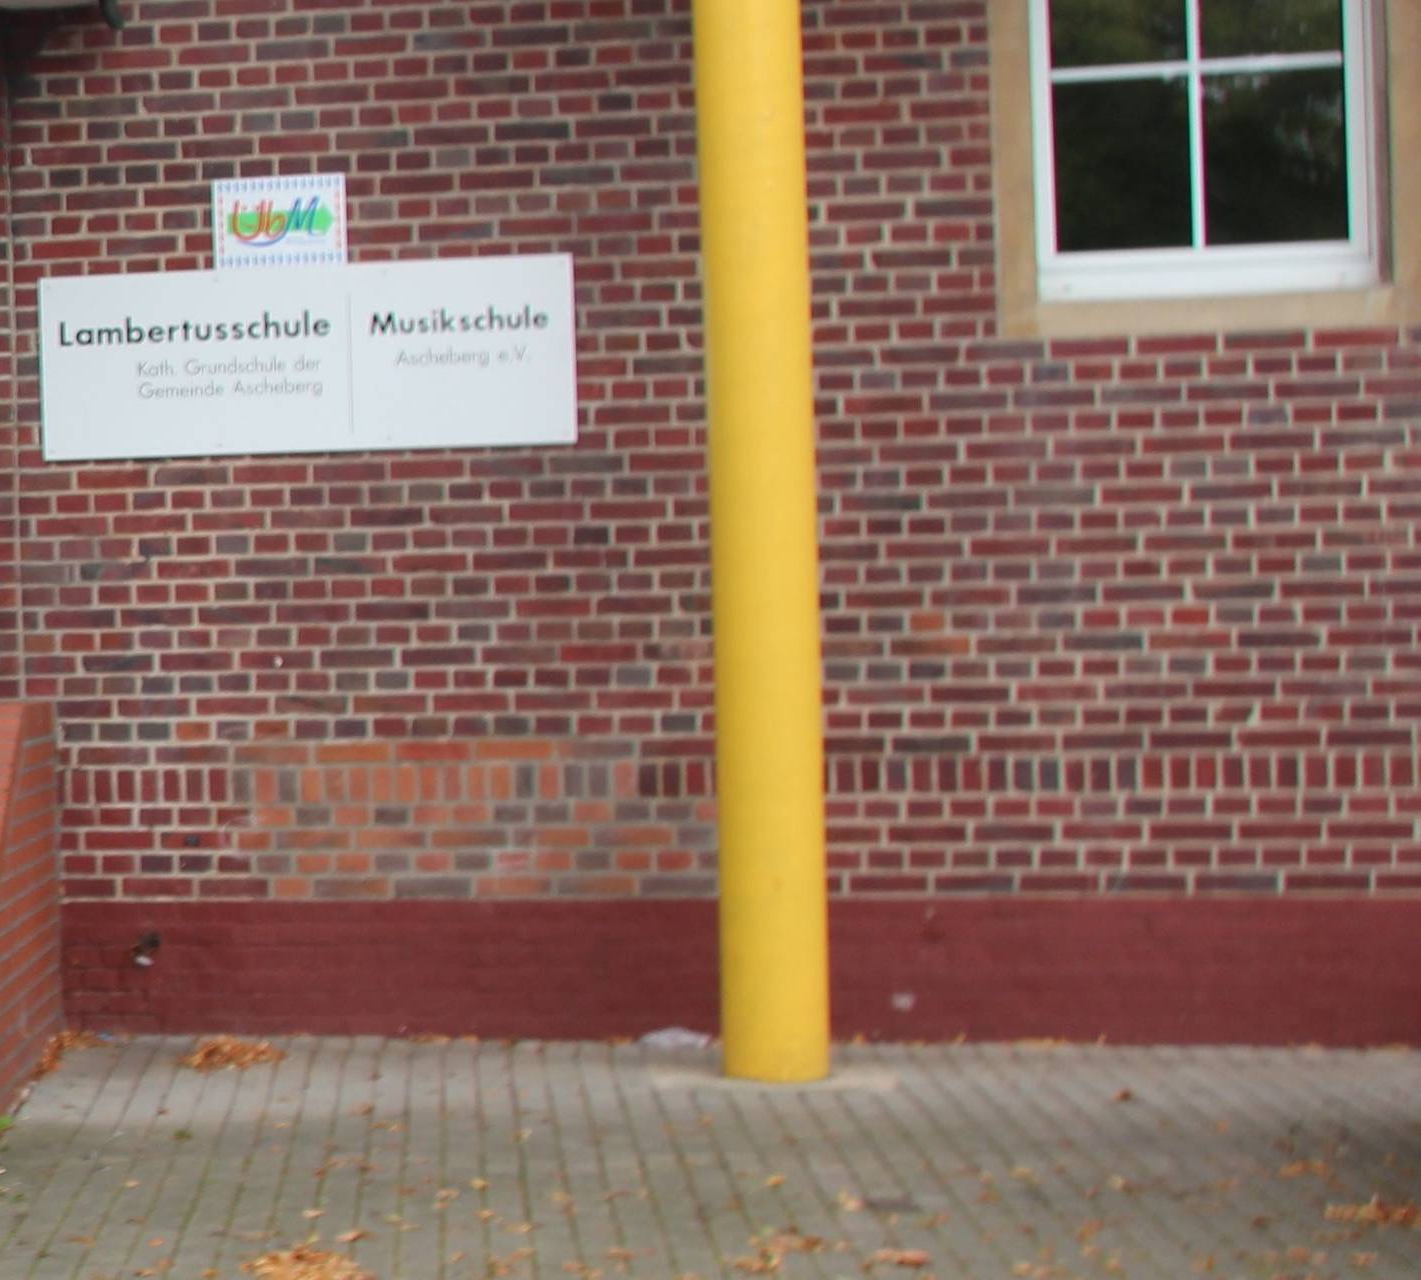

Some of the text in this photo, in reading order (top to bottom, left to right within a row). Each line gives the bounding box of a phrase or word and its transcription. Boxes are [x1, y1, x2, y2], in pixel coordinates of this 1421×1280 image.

[59, 310, 332, 347] Lambertusschule
[369, 305, 550, 336] Musikschule
[137, 354, 321, 377] Kath. Grundschule der
[396, 345, 530, 367] Ascheberg e.V.
[138, 376, 323, 398] Gemeinde Ascheberg
